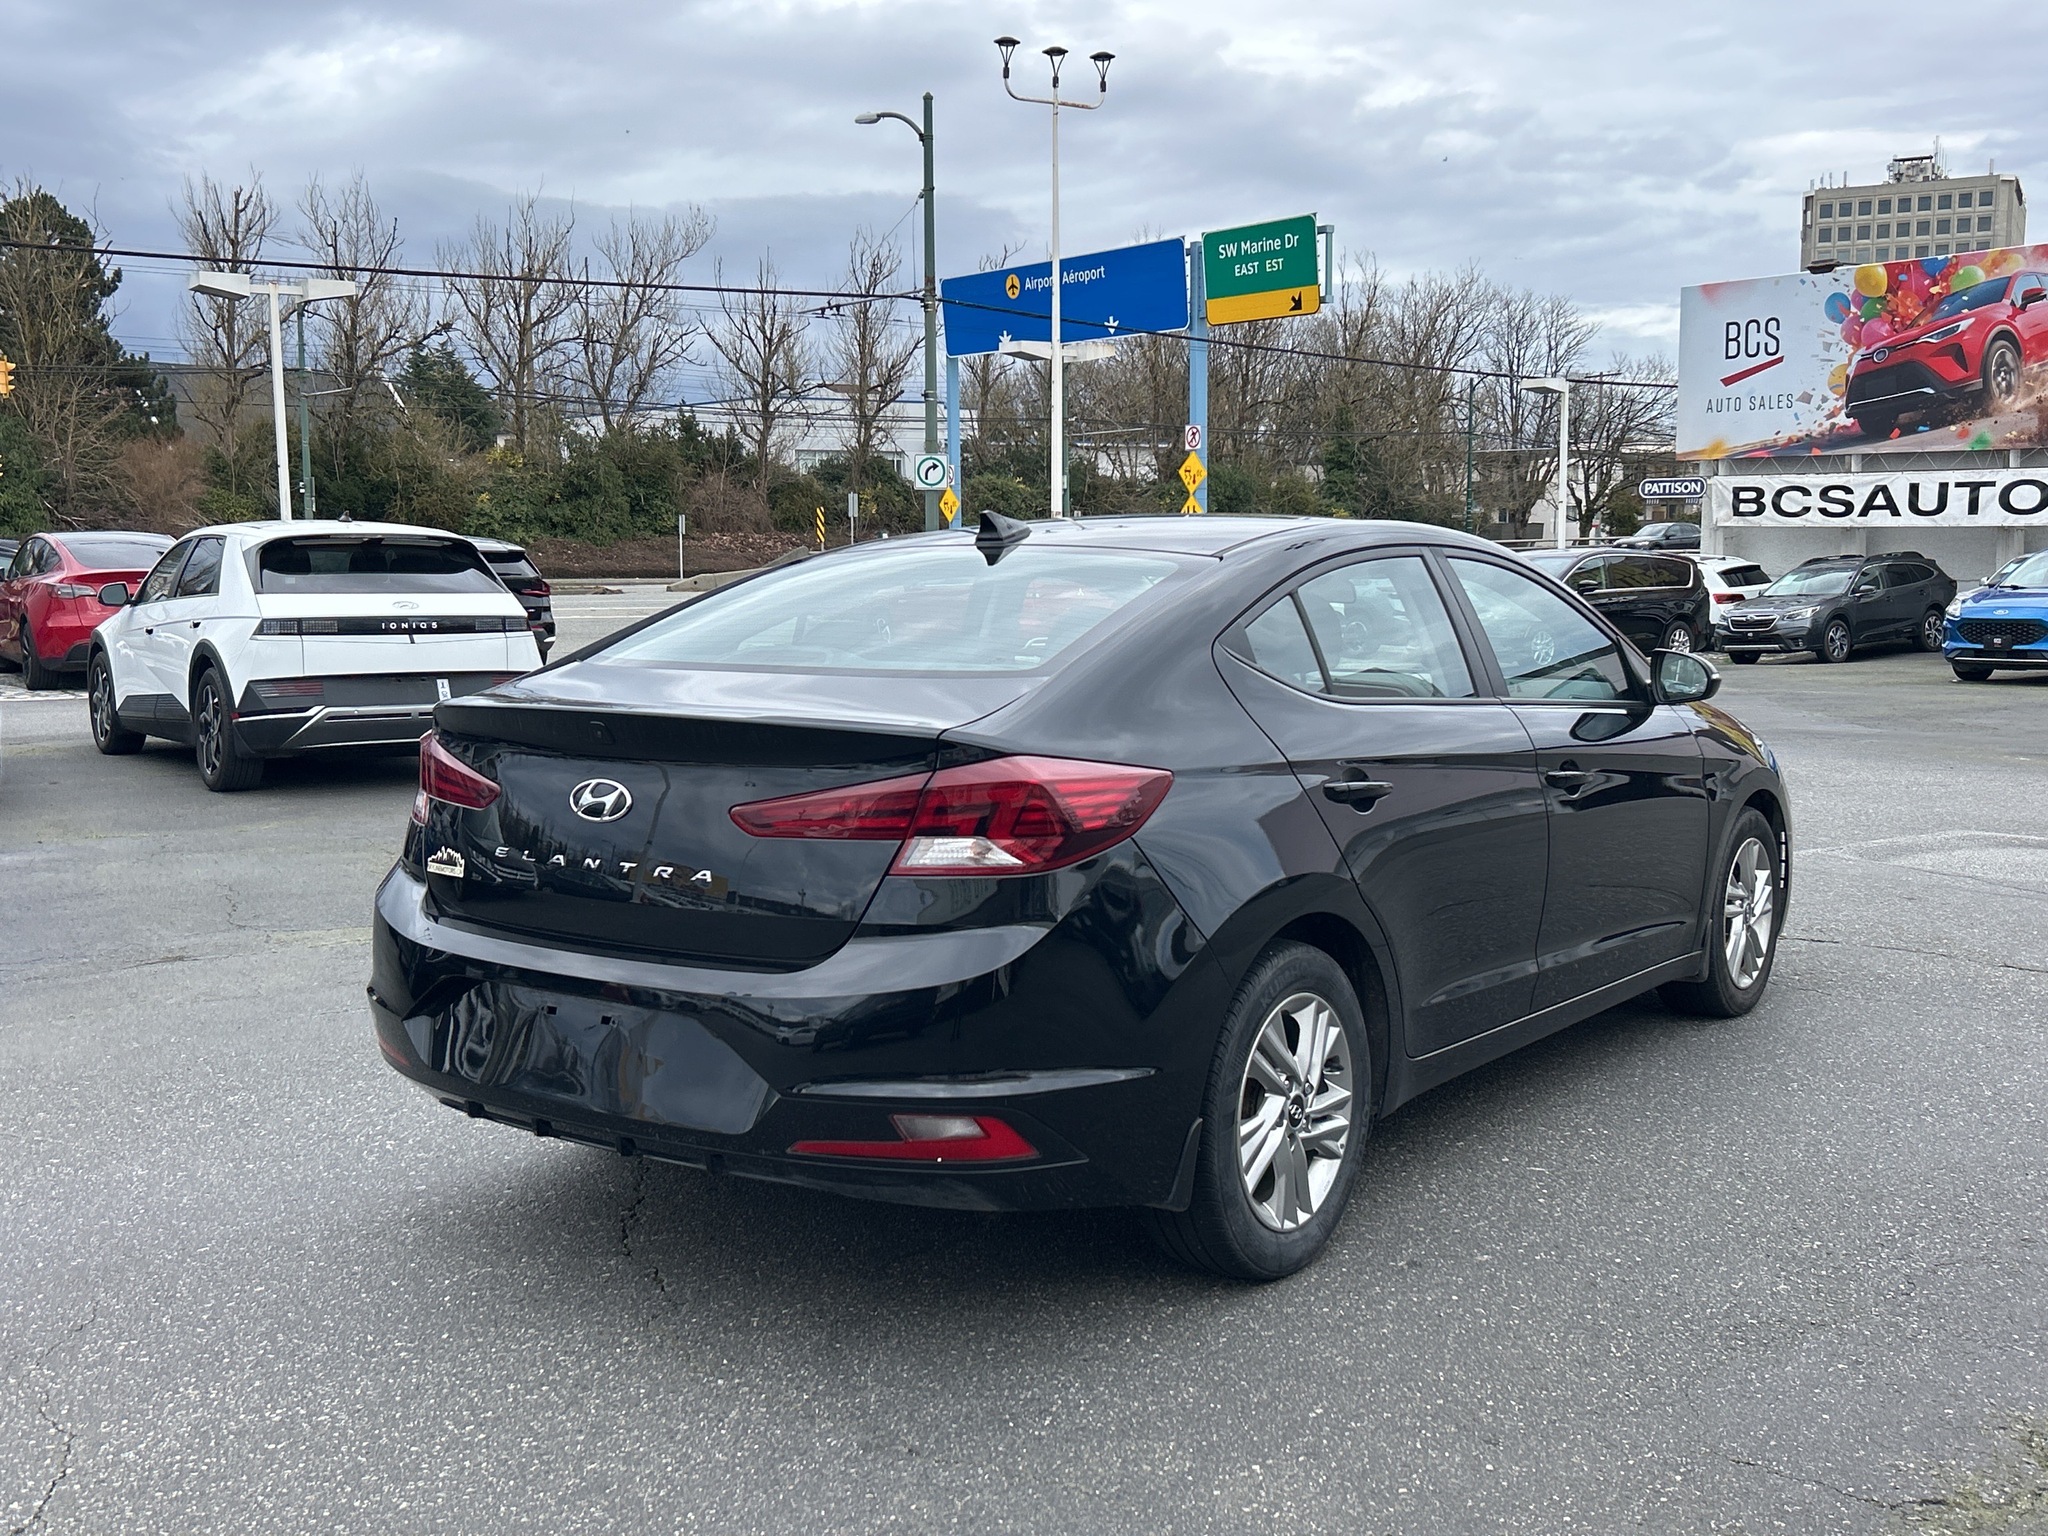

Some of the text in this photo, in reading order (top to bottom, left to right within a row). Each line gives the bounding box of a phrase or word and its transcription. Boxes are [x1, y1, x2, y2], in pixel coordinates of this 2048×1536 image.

[1218, 233, 1299, 259] SW Marine Dr
[1025, 265, 1105, 292] Airpor Aéroport
[1234, 258, 1284, 277] EAST EST
[1725, 316, 1780, 360] BCS
[1706, 393, 1794, 413] AUTO SALES
[1644, 481, 1701, 494] PATTISON
[1731, 478, 2048, 518] BCSAUTO
[494, 846, 713, 882] ELANTRA
